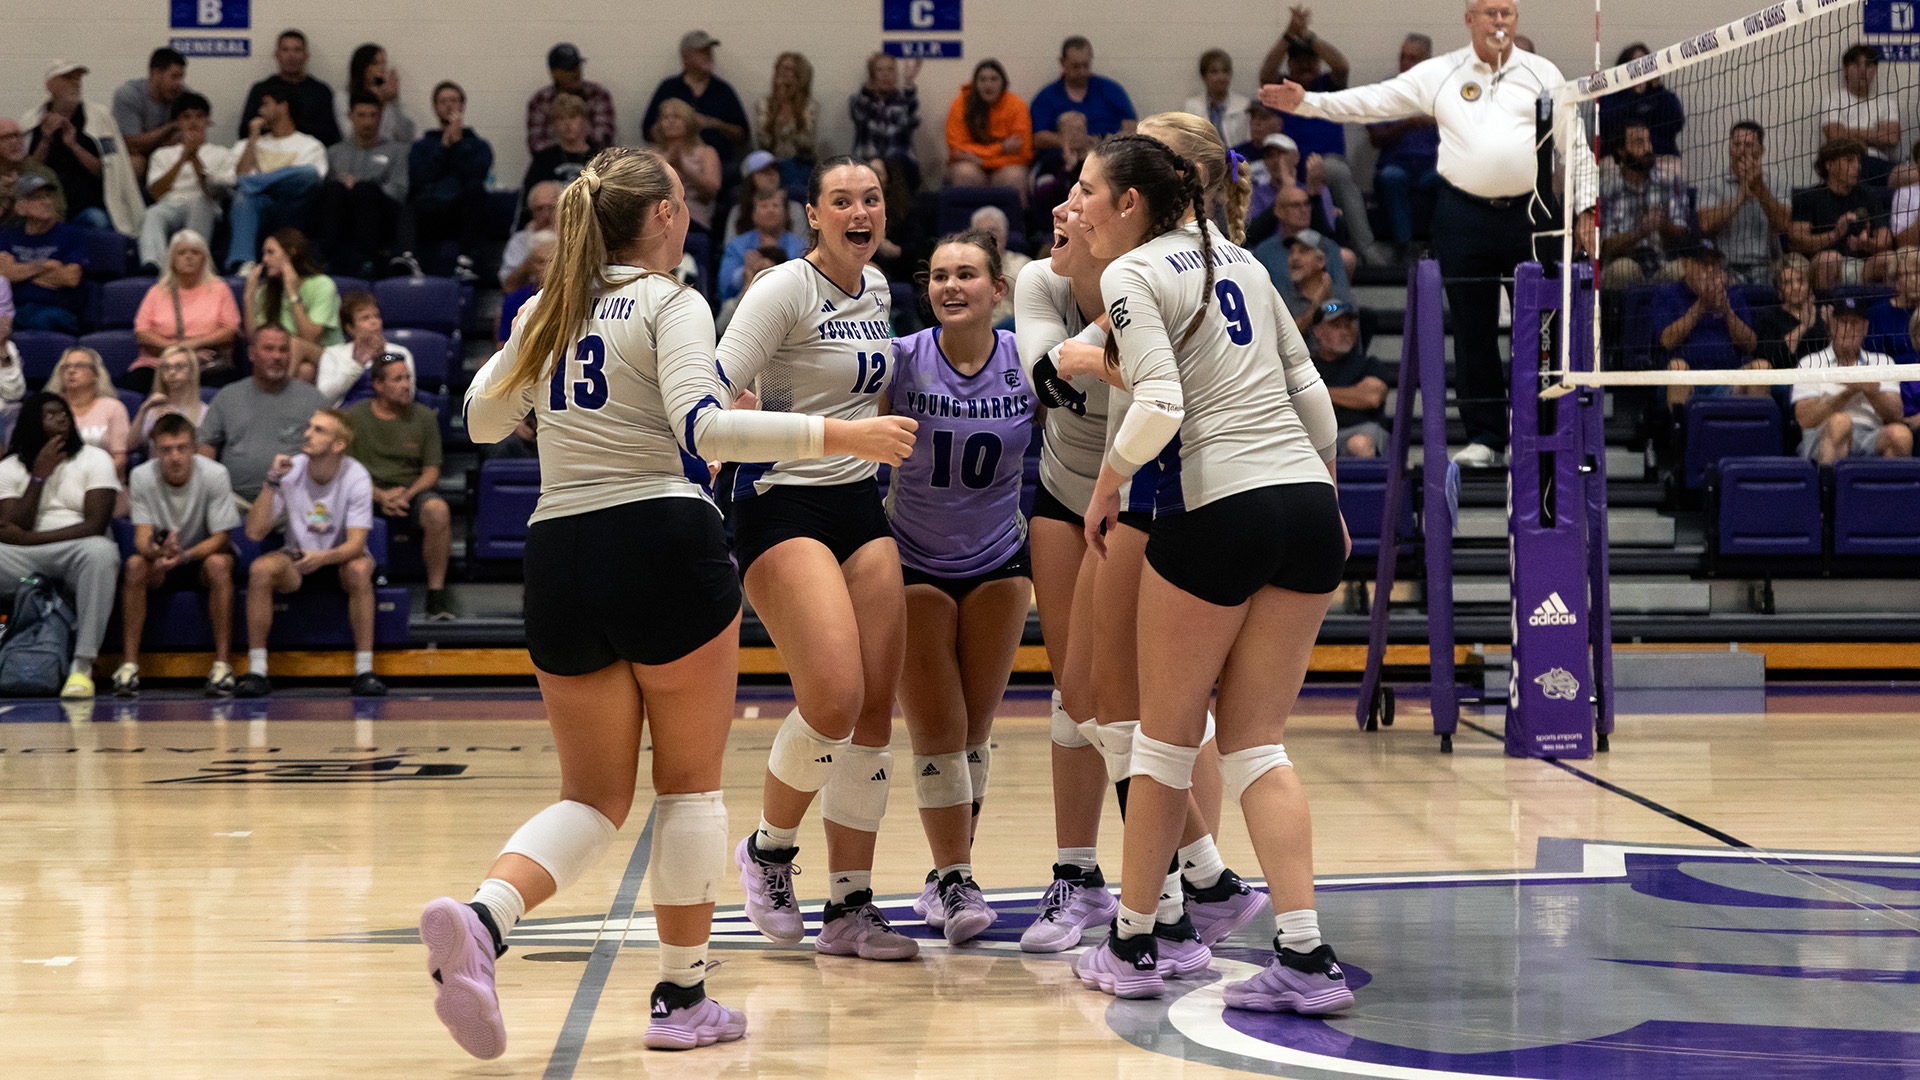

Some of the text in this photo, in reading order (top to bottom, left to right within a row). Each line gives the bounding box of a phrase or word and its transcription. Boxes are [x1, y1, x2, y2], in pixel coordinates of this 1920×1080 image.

[196, 0, 223, 25] B
[910, 0, 935, 27] C
[1743, 3, 1786, 36] YOUNG HARRIS
[1891, 2, 1915, 31] D
[172, 41, 245, 54] GENERAL
[1680, 38, 1698, 60] YOUNG
[598, 297, 636, 320] LIONS
[1214, 278, 1254, 347] 9
[818, 321, 862, 340] YOUNG
[549, 334, 609, 411] 13
[850, 351, 887, 394] 12
[907, 391, 1029, 419] YOUNG HARRIS
[928, 429, 1004, 490] 10
[1529, 612, 1577, 626] adidas
